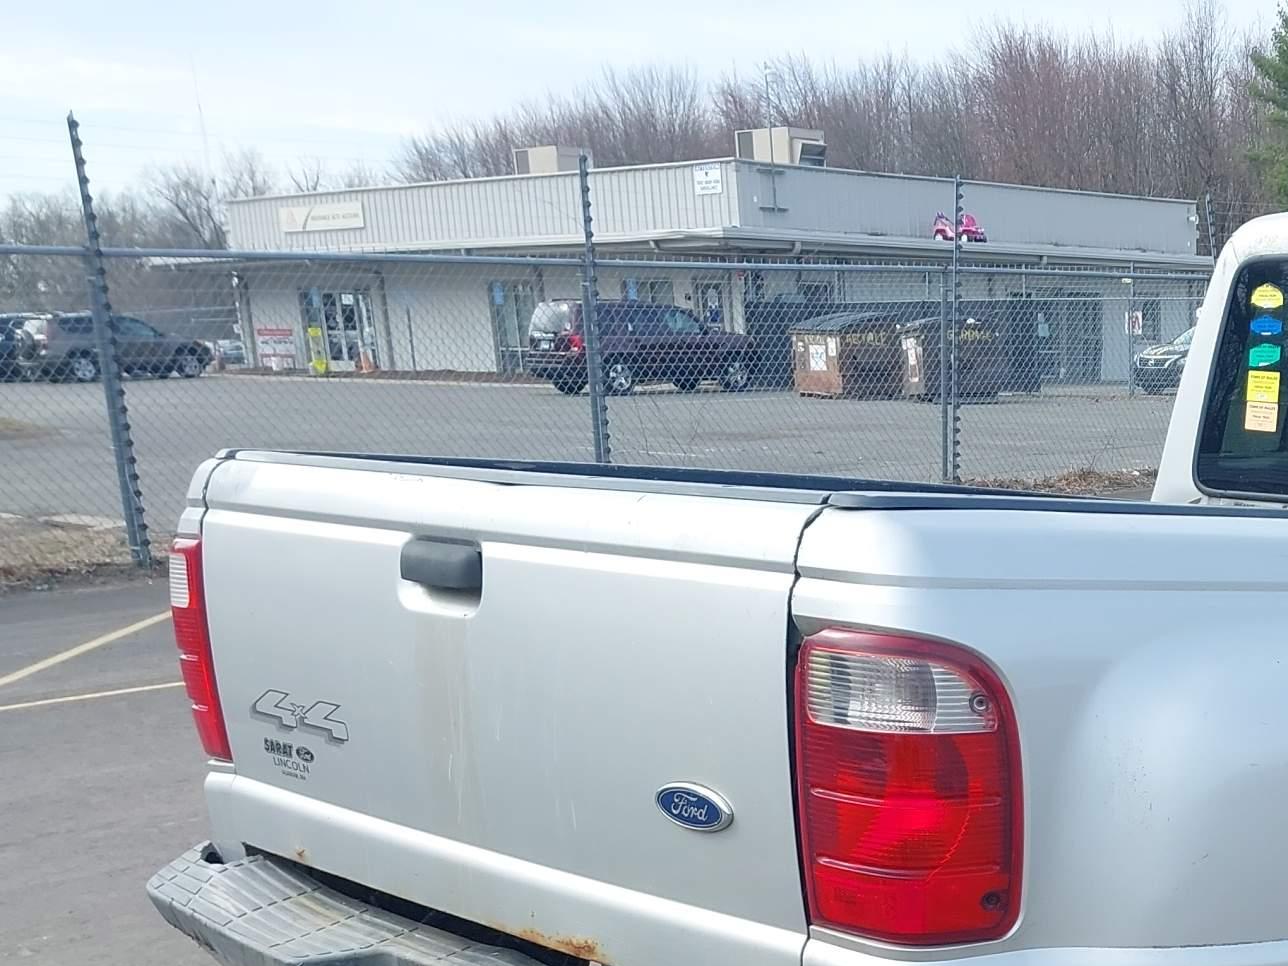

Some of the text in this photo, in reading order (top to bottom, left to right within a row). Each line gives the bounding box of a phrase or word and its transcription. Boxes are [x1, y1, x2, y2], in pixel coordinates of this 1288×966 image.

[263, 736, 293, 759] SARAT
[272, 756, 310, 774] LINCOLN
[671, 792, 709, 822] Ford
